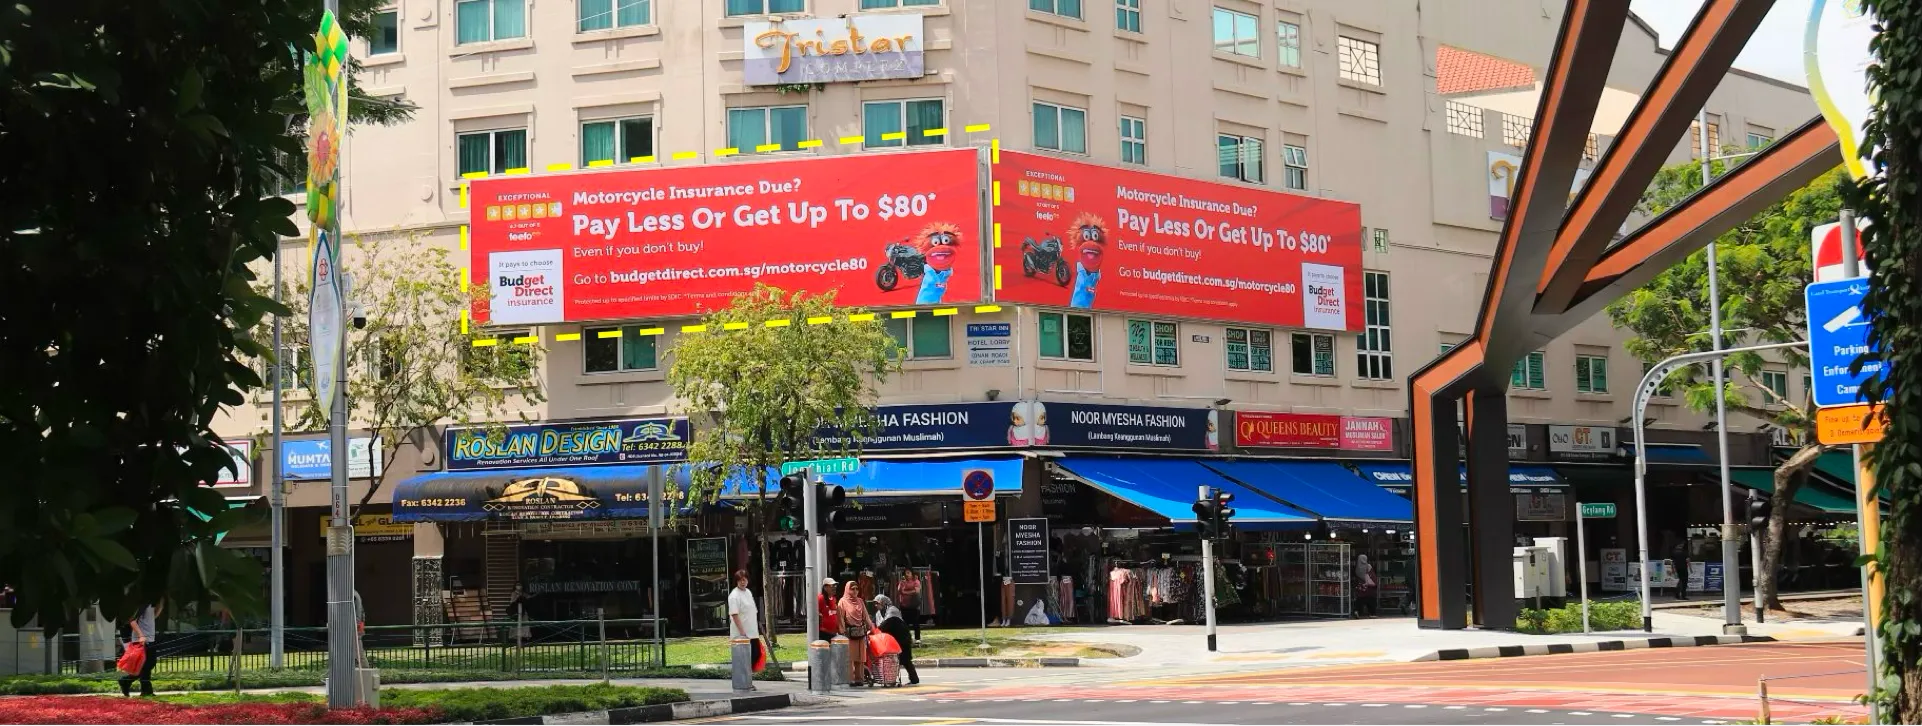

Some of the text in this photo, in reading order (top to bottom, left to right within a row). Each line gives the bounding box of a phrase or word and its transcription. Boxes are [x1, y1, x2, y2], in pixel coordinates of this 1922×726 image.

[755, 25, 913, 74] Tristar
[1026, 171, 1065, 182] EXCEPTIONAL
[497, 192, 551, 201] EXCEPTIONAL
[573, 178, 802, 206] Motorcycle Insurance Due?
[1117, 185, 1257, 217] Motorcycle Insurance Due?
[573, 213, 620, 240] Pay
[627, 211, 685, 232] Less
[691, 207, 727, 229] Or
[733, 205, 781, 227] Get
[788, 201, 828, 228] Up
[834, 198, 870, 221] To
[509, 231, 533, 241] feefo
[1117, 208, 1150, 236] Pay
[1153, 213, 1190, 237] Less
[1194, 219, 1215, 240] Or
[1218, 222, 1247, 244] Get
[1250, 227, 1274, 252] Up
[1276, 229, 1296, 250] To
[573, 240, 704, 260] Even if you don't buy!
[1118, 240, 1201, 261] Even if you don't buy!
[573, 258, 867, 286] Go to budgetdirect.com.sg/motorcycle80
[499, 274, 544, 288] Budget
[1119, 266, 1295, 294] Go to budgetdirect.com.sg/motorcycle80
[514, 285, 553, 297] Direct
[1308, 284, 1335, 298] Budget
[508, 298, 553, 307] insurance
[1317, 295, 1340, 307] Direct
[1155, 324, 1174, 333] SHOP
[1227, 330, 1244, 339] SHOP
[1833, 344, 1869, 356] Parking
[1837, 384, 1861, 395] Cam
[902, 411, 969, 427] FASHION
[1071, 410, 1186, 428] NOOR MYESHA FASHION
[1257, 421, 1339, 438] QUEENS BEAUTY
[1345, 421, 1379, 431] JANNAH
[903, 432, 944, 442] Muslimah)
[454, 428, 623, 460] ROSLAN DESIGN
[622, 441, 683, 452] Tel: 6342 2288
[287, 452, 331, 465] MUMTA
[583, 454, 599, 462] Roof
[842, 461, 854, 471] Rd
[1041, 484, 1076, 494] FASHION
[401, 498, 466, 507] Fax: 6342 2236
[615, 493, 633, 502] Tel:
[1582, 505, 1614, 516] Geylang Rd
[529, 581, 614, 593] ROSLAN RENOVATION
